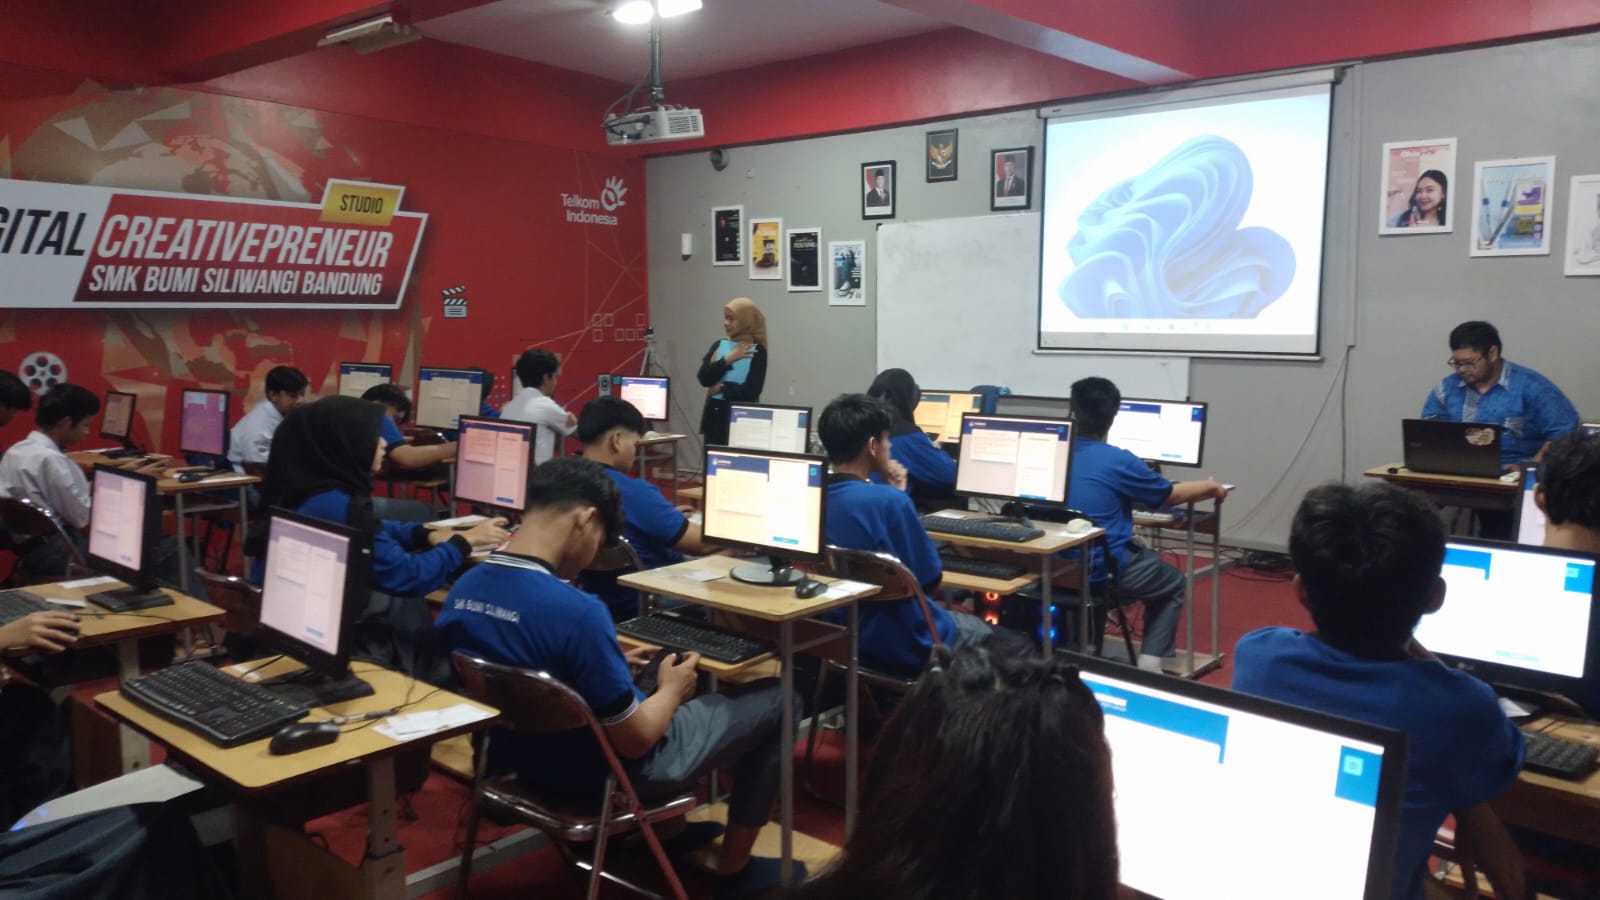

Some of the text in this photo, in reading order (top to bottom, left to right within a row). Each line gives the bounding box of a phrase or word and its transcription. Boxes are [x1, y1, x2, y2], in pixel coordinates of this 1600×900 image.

[340, 194, 384, 214] STUDIO
[560, 193, 600, 210] Telkom
[566, 210, 618, 226] Indonesia
[0, 206, 394, 268] ITAL CREATIVEPRENEUR
[89, 265, 383, 295] SMK BUMI SILIWANGI BANDUNG
